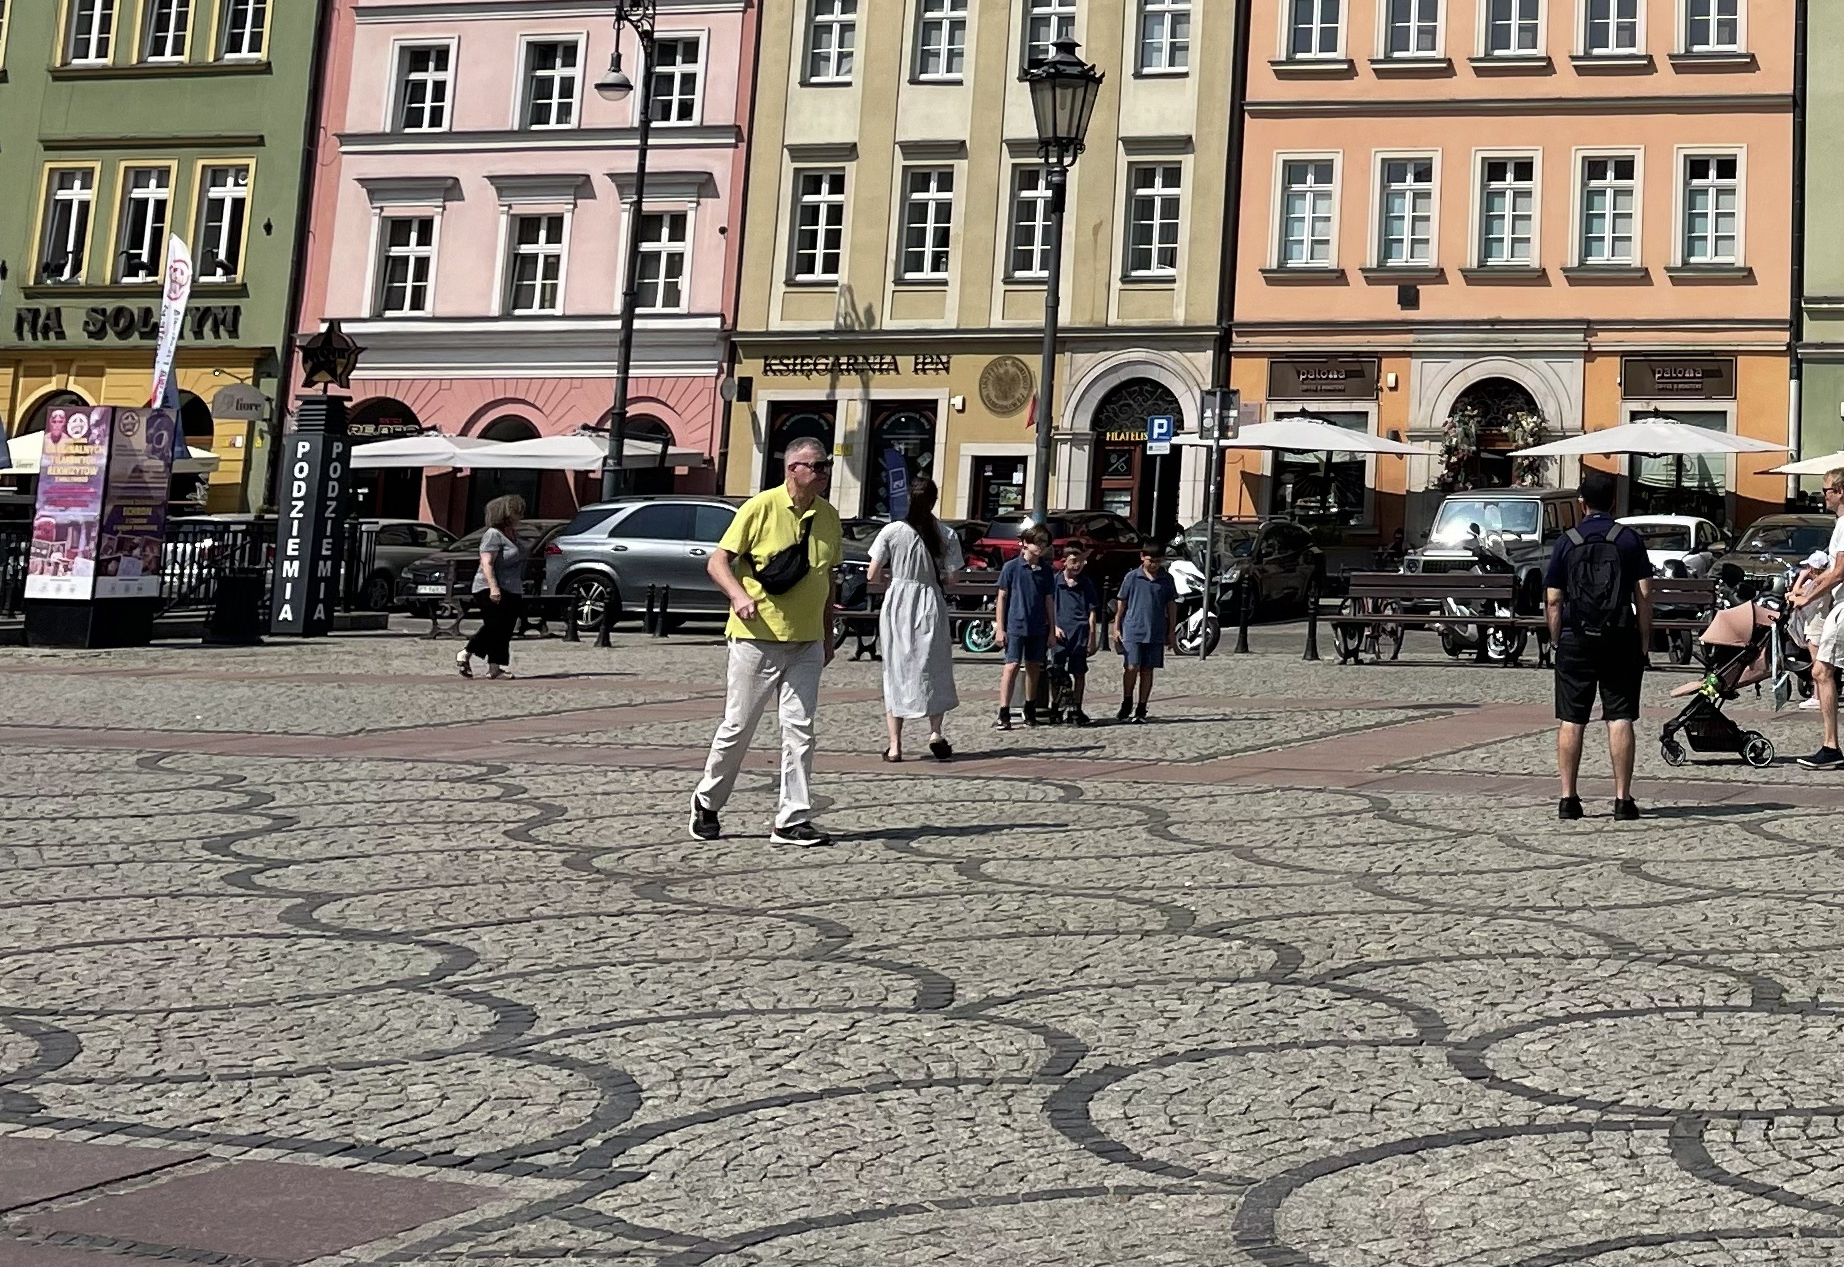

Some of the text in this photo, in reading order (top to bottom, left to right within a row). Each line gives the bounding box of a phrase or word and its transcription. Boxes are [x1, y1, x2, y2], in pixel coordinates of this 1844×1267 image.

[14, 306, 67, 341] NA
[82, 305, 242, 340] SOLYM
[1106, 432, 1149, 440] FILATELIS
[1153, 419, 1168, 439] P
[278, 441, 311, 621] PODZIEMIA
[313, 442, 343, 621] PODZIEMIA
